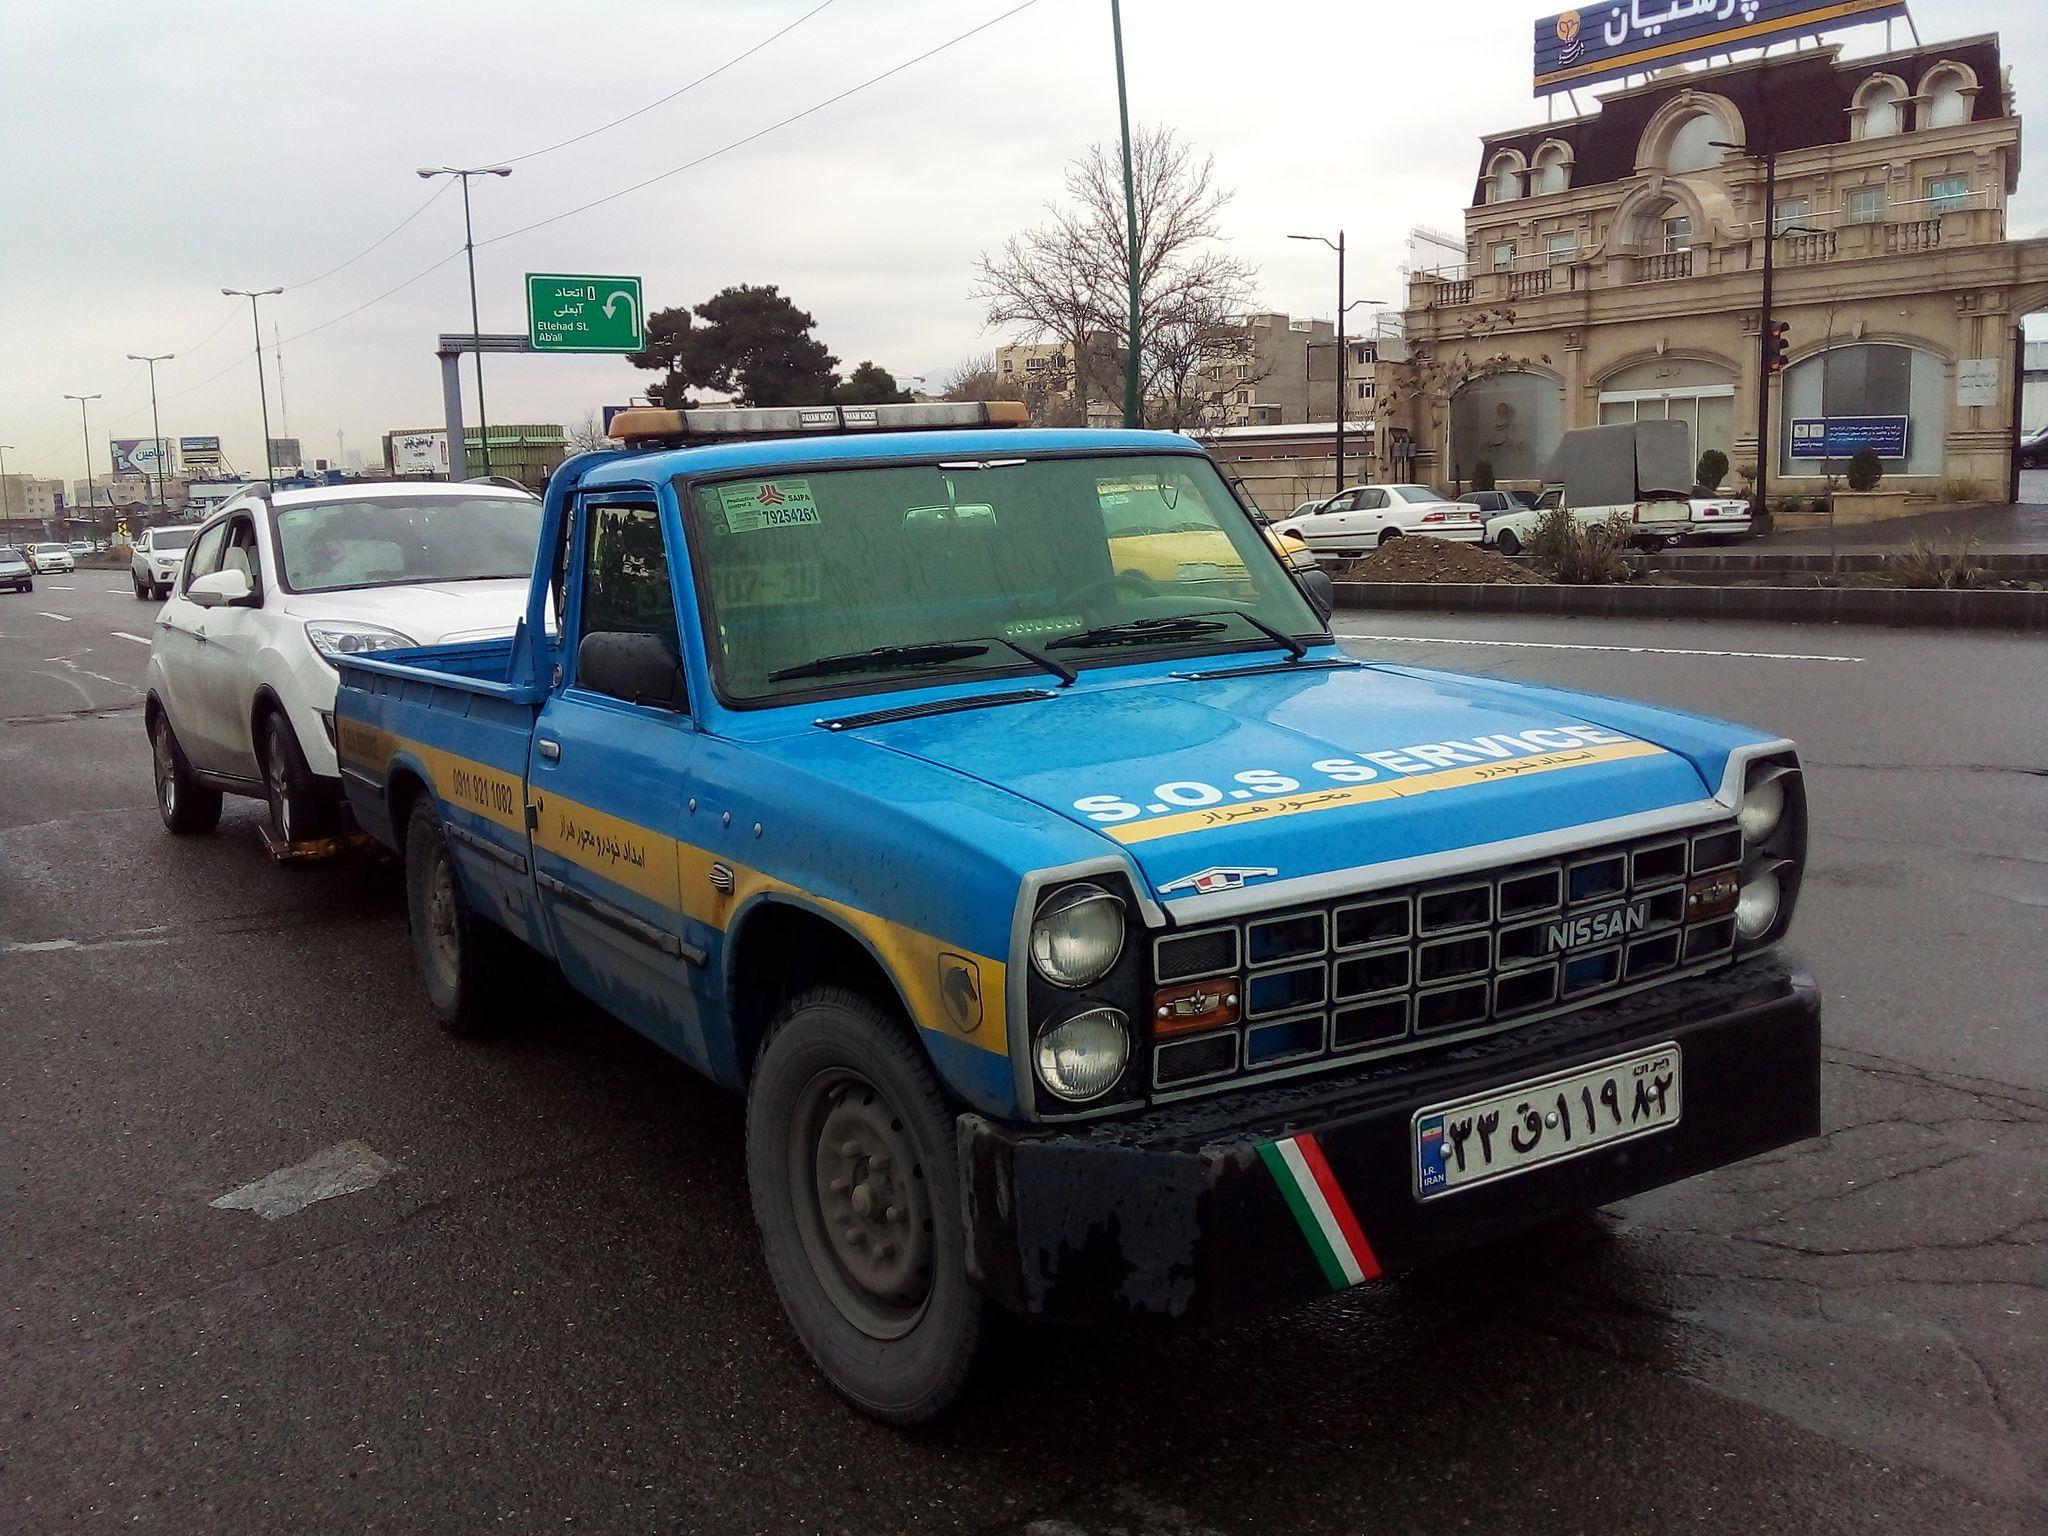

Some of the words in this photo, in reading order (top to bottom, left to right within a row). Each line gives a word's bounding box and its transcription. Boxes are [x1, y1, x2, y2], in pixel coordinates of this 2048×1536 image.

[555, 287, 583, 297] اتحاد
[553, 303, 584, 317] آبعلی
[537, 321, 574, 331] Ettehad
[576, 321, 589, 331] St.
[802, 413, 820, 422] PAYAM
[860, 411, 877, 420] NOOR
[787, 494, 811, 502] SAIPA
[761, 507, 818, 526] 79254261
[1543, 751, 1595, 766] امداد
[1073, 769, 1300, 822] S.O.S
[1312, 725, 1631, 782] SERVICE
[1475, 760, 1538, 779] خودرو
[452, 768, 471, 800] 0911
[473, 774, 488, 807] 921
[491, 780, 513, 816] 1082
[1278, 791, 1352, 812] محور
[1201, 805, 1268, 824] هراز
[560, 814, 576, 841] هراز
[623, 840, 645, 868] امداد
[1548, 904, 1645, 953] NISSAN
[1633, 1057, 1670, 1076] ایران
[1424, 1174, 1445, 1187] IRAN
